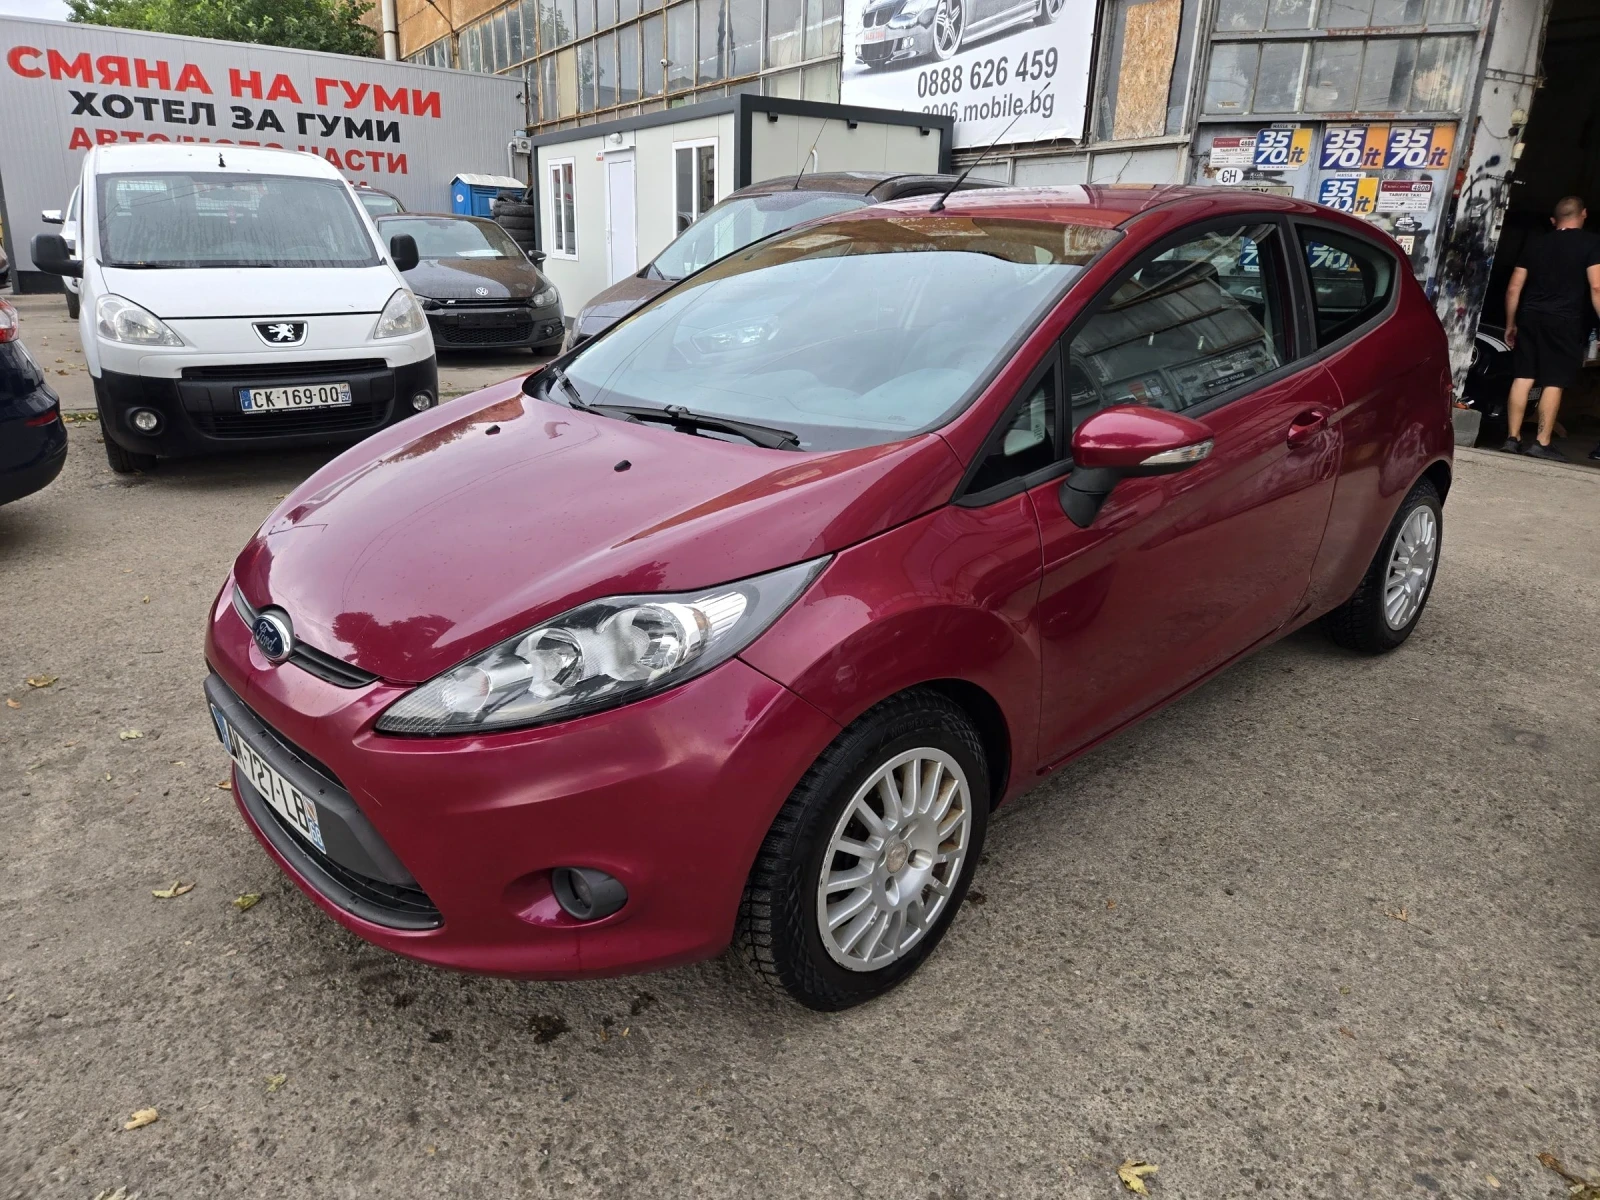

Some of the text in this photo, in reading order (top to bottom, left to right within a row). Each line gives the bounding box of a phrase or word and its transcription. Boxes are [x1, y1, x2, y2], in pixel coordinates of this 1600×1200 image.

[7, 45, 441, 118] СМЯНА НА ГУМИ
[917, 46, 1058, 98] 0888 626 459
[68, 90, 217, 127] ХОТЕЛ
[230, 105, 285, 133] ЗА
[296, 112, 401, 143] ГУМИ
[1259, 131, 1292, 147] 35
[1325, 129, 1365, 148] 35
[1390, 129, 1432, 148] 35
[1322, 180, 1357, 197] 35
[255, 621, 278, 652] Ford
